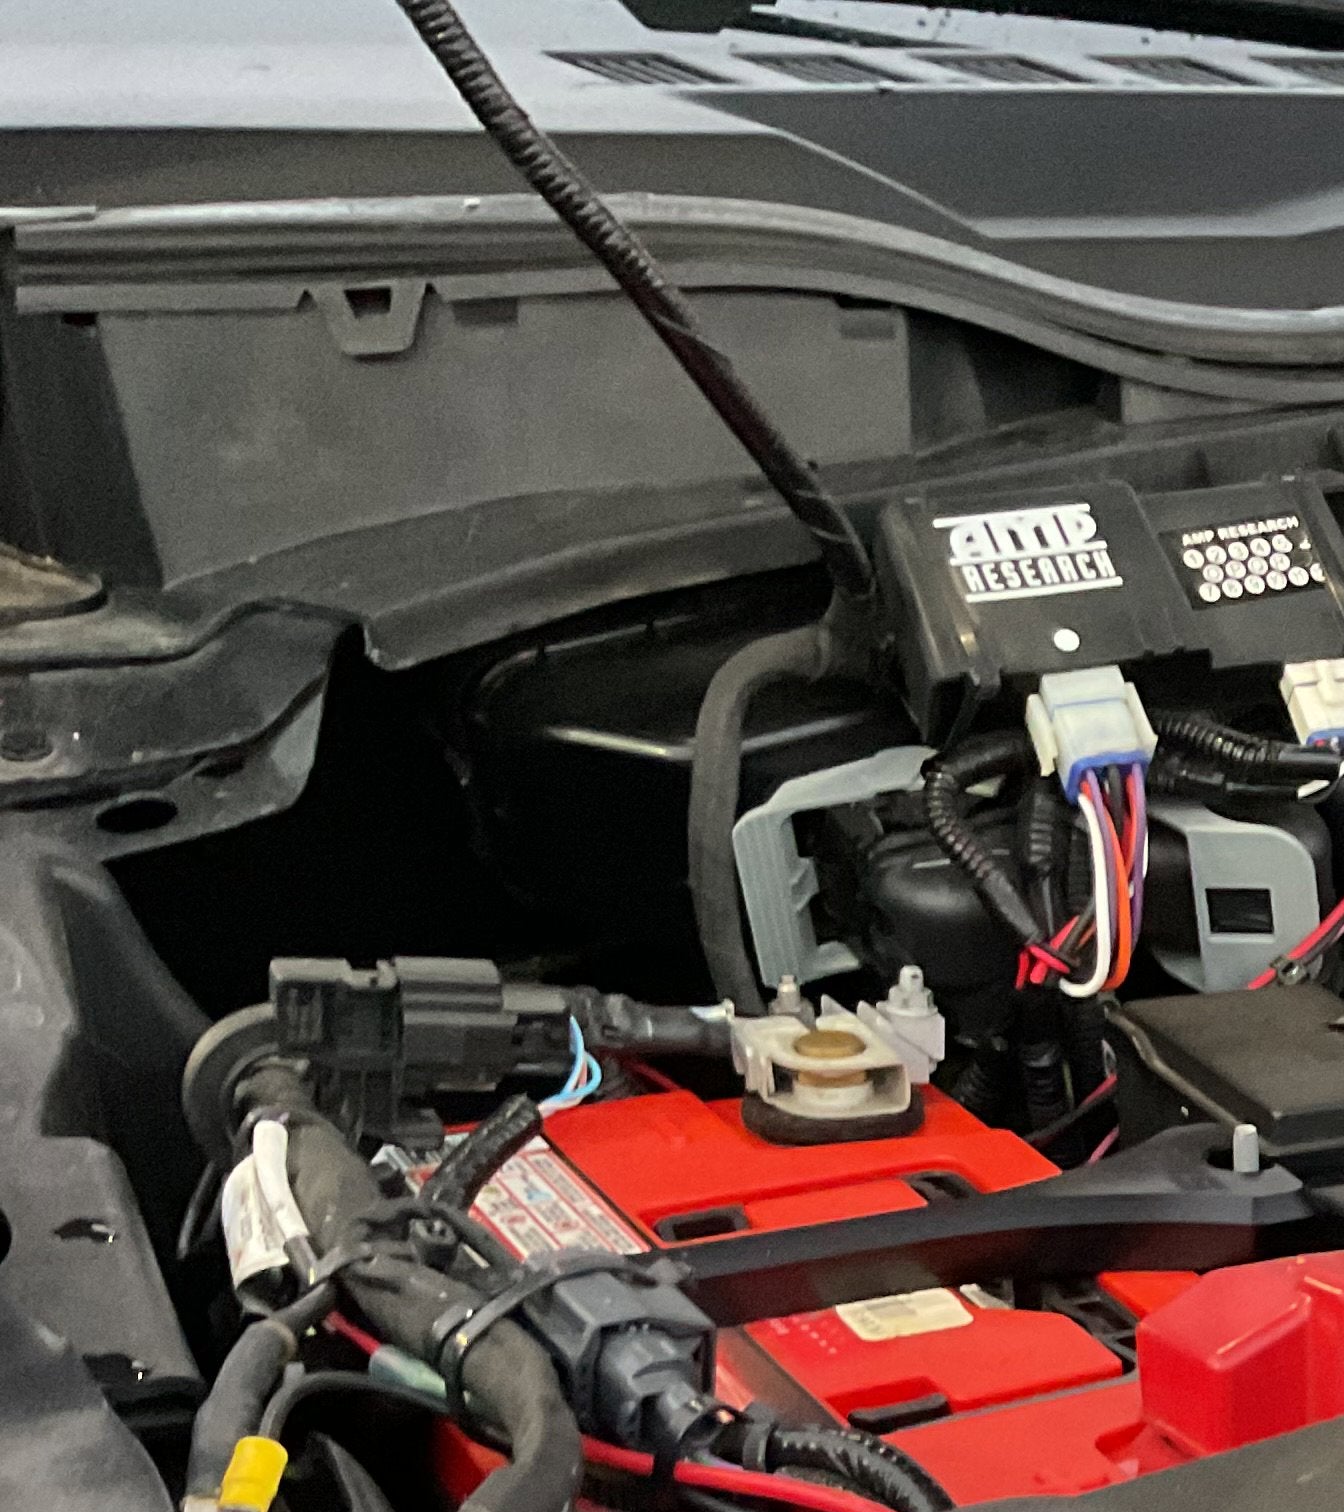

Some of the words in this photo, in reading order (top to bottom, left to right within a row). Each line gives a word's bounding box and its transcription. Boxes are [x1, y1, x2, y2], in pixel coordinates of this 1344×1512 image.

[1182, 529, 1215, 546] AMP
[1217, 515, 1299, 541] RESEARCH
[962, 550, 1116, 592] RESEARCH
